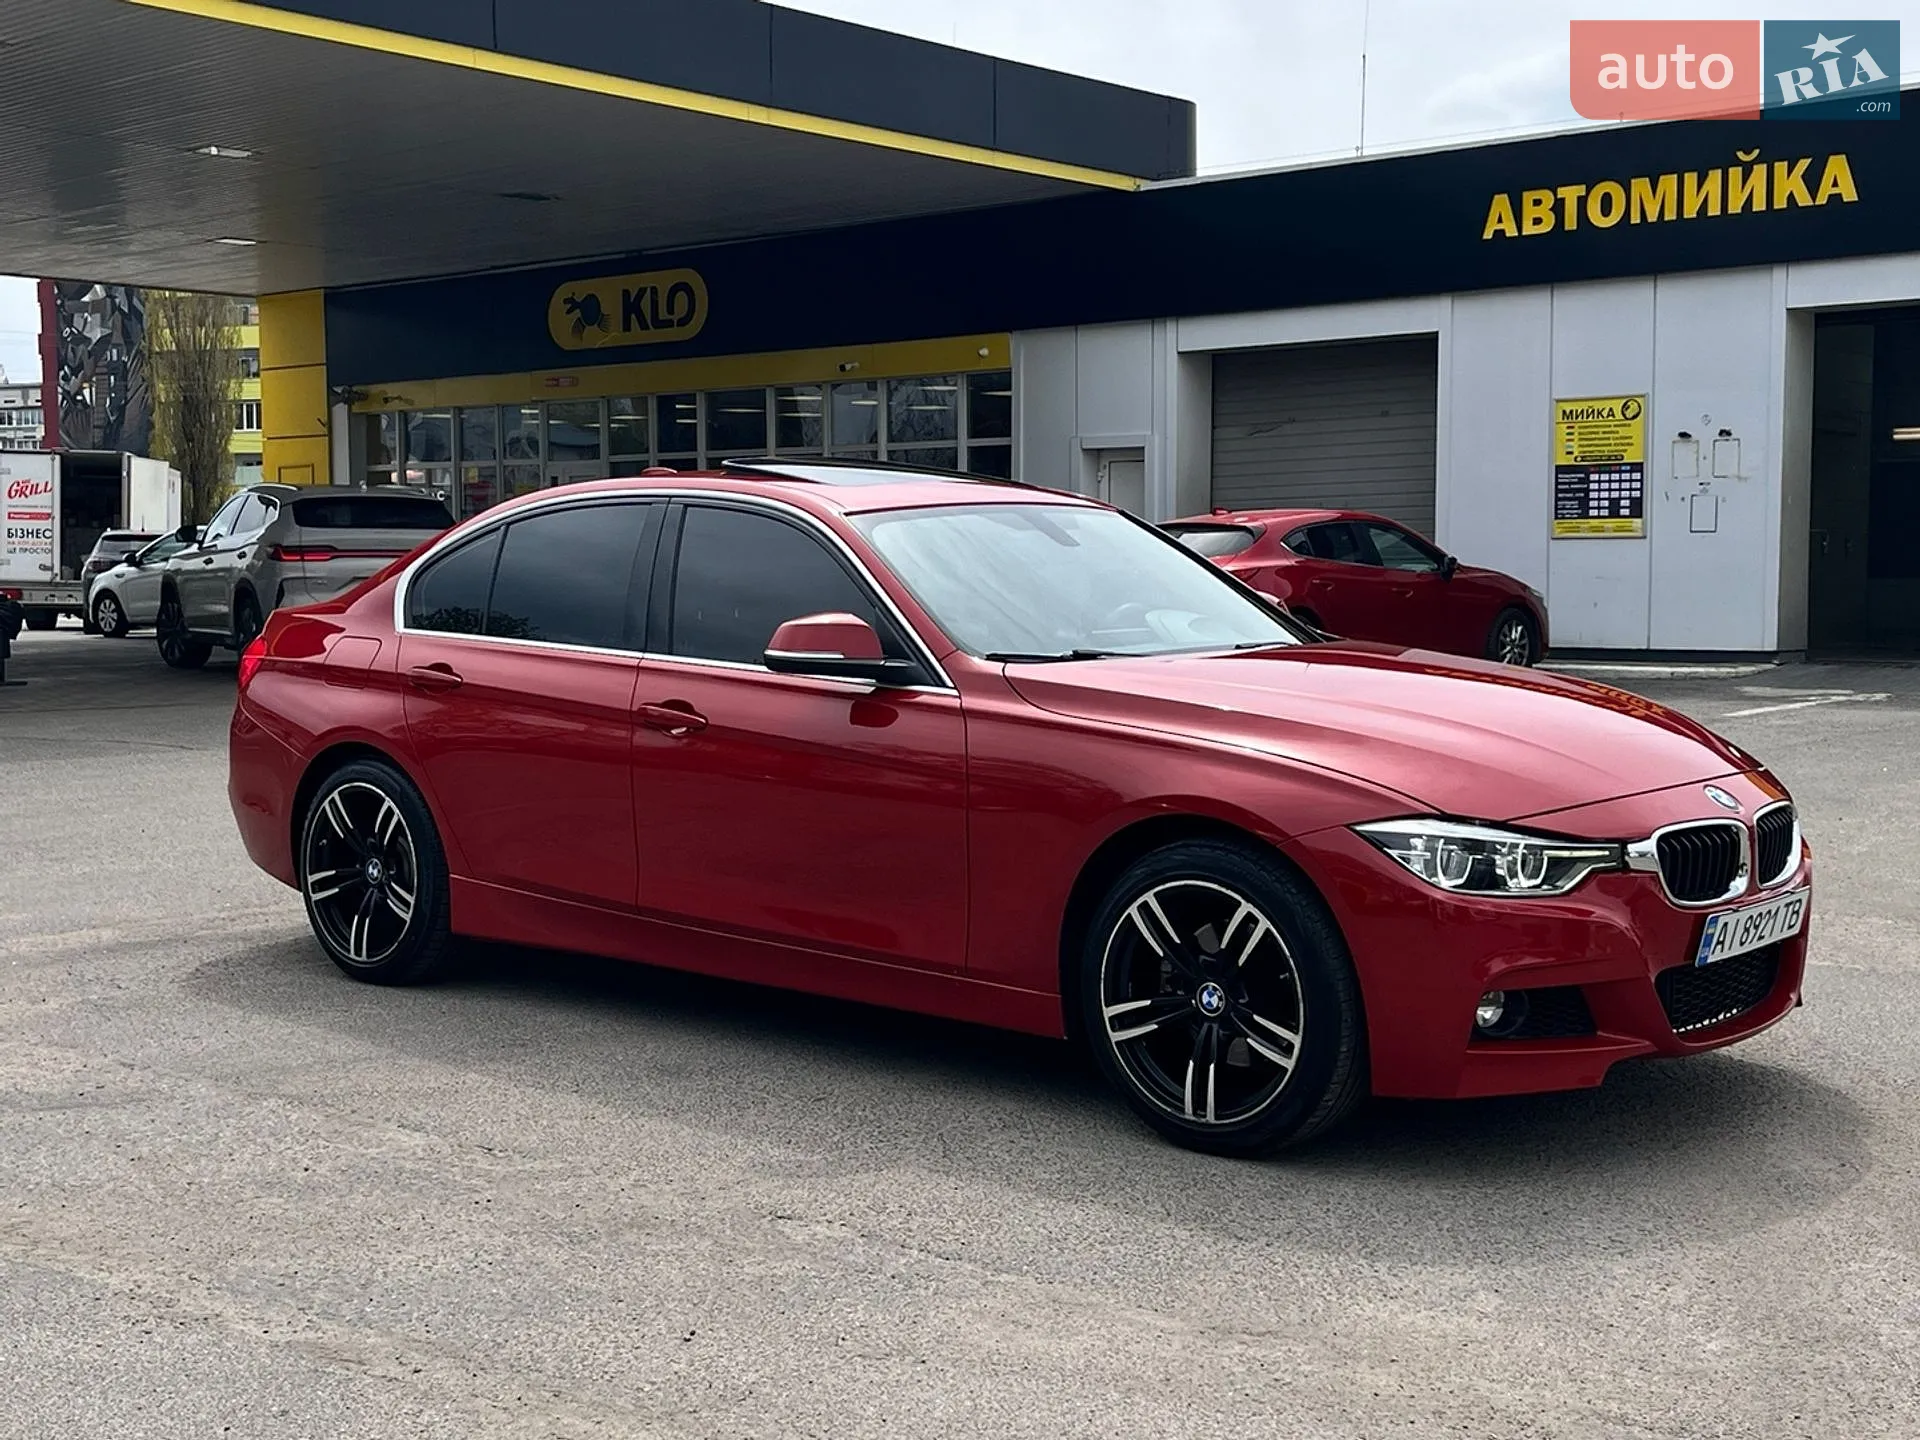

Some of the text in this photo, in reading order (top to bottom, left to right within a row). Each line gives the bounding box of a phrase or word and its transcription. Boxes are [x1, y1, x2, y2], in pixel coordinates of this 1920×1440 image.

[1481, 147, 1860, 241] АВТОМИЙКА
[621, 280, 697, 333] KLO
[1561, 405, 1616, 421] МИЙКА
[7, 479, 53, 499] GRILL
[1711, 899, 1802, 956] AI 8921 TB
